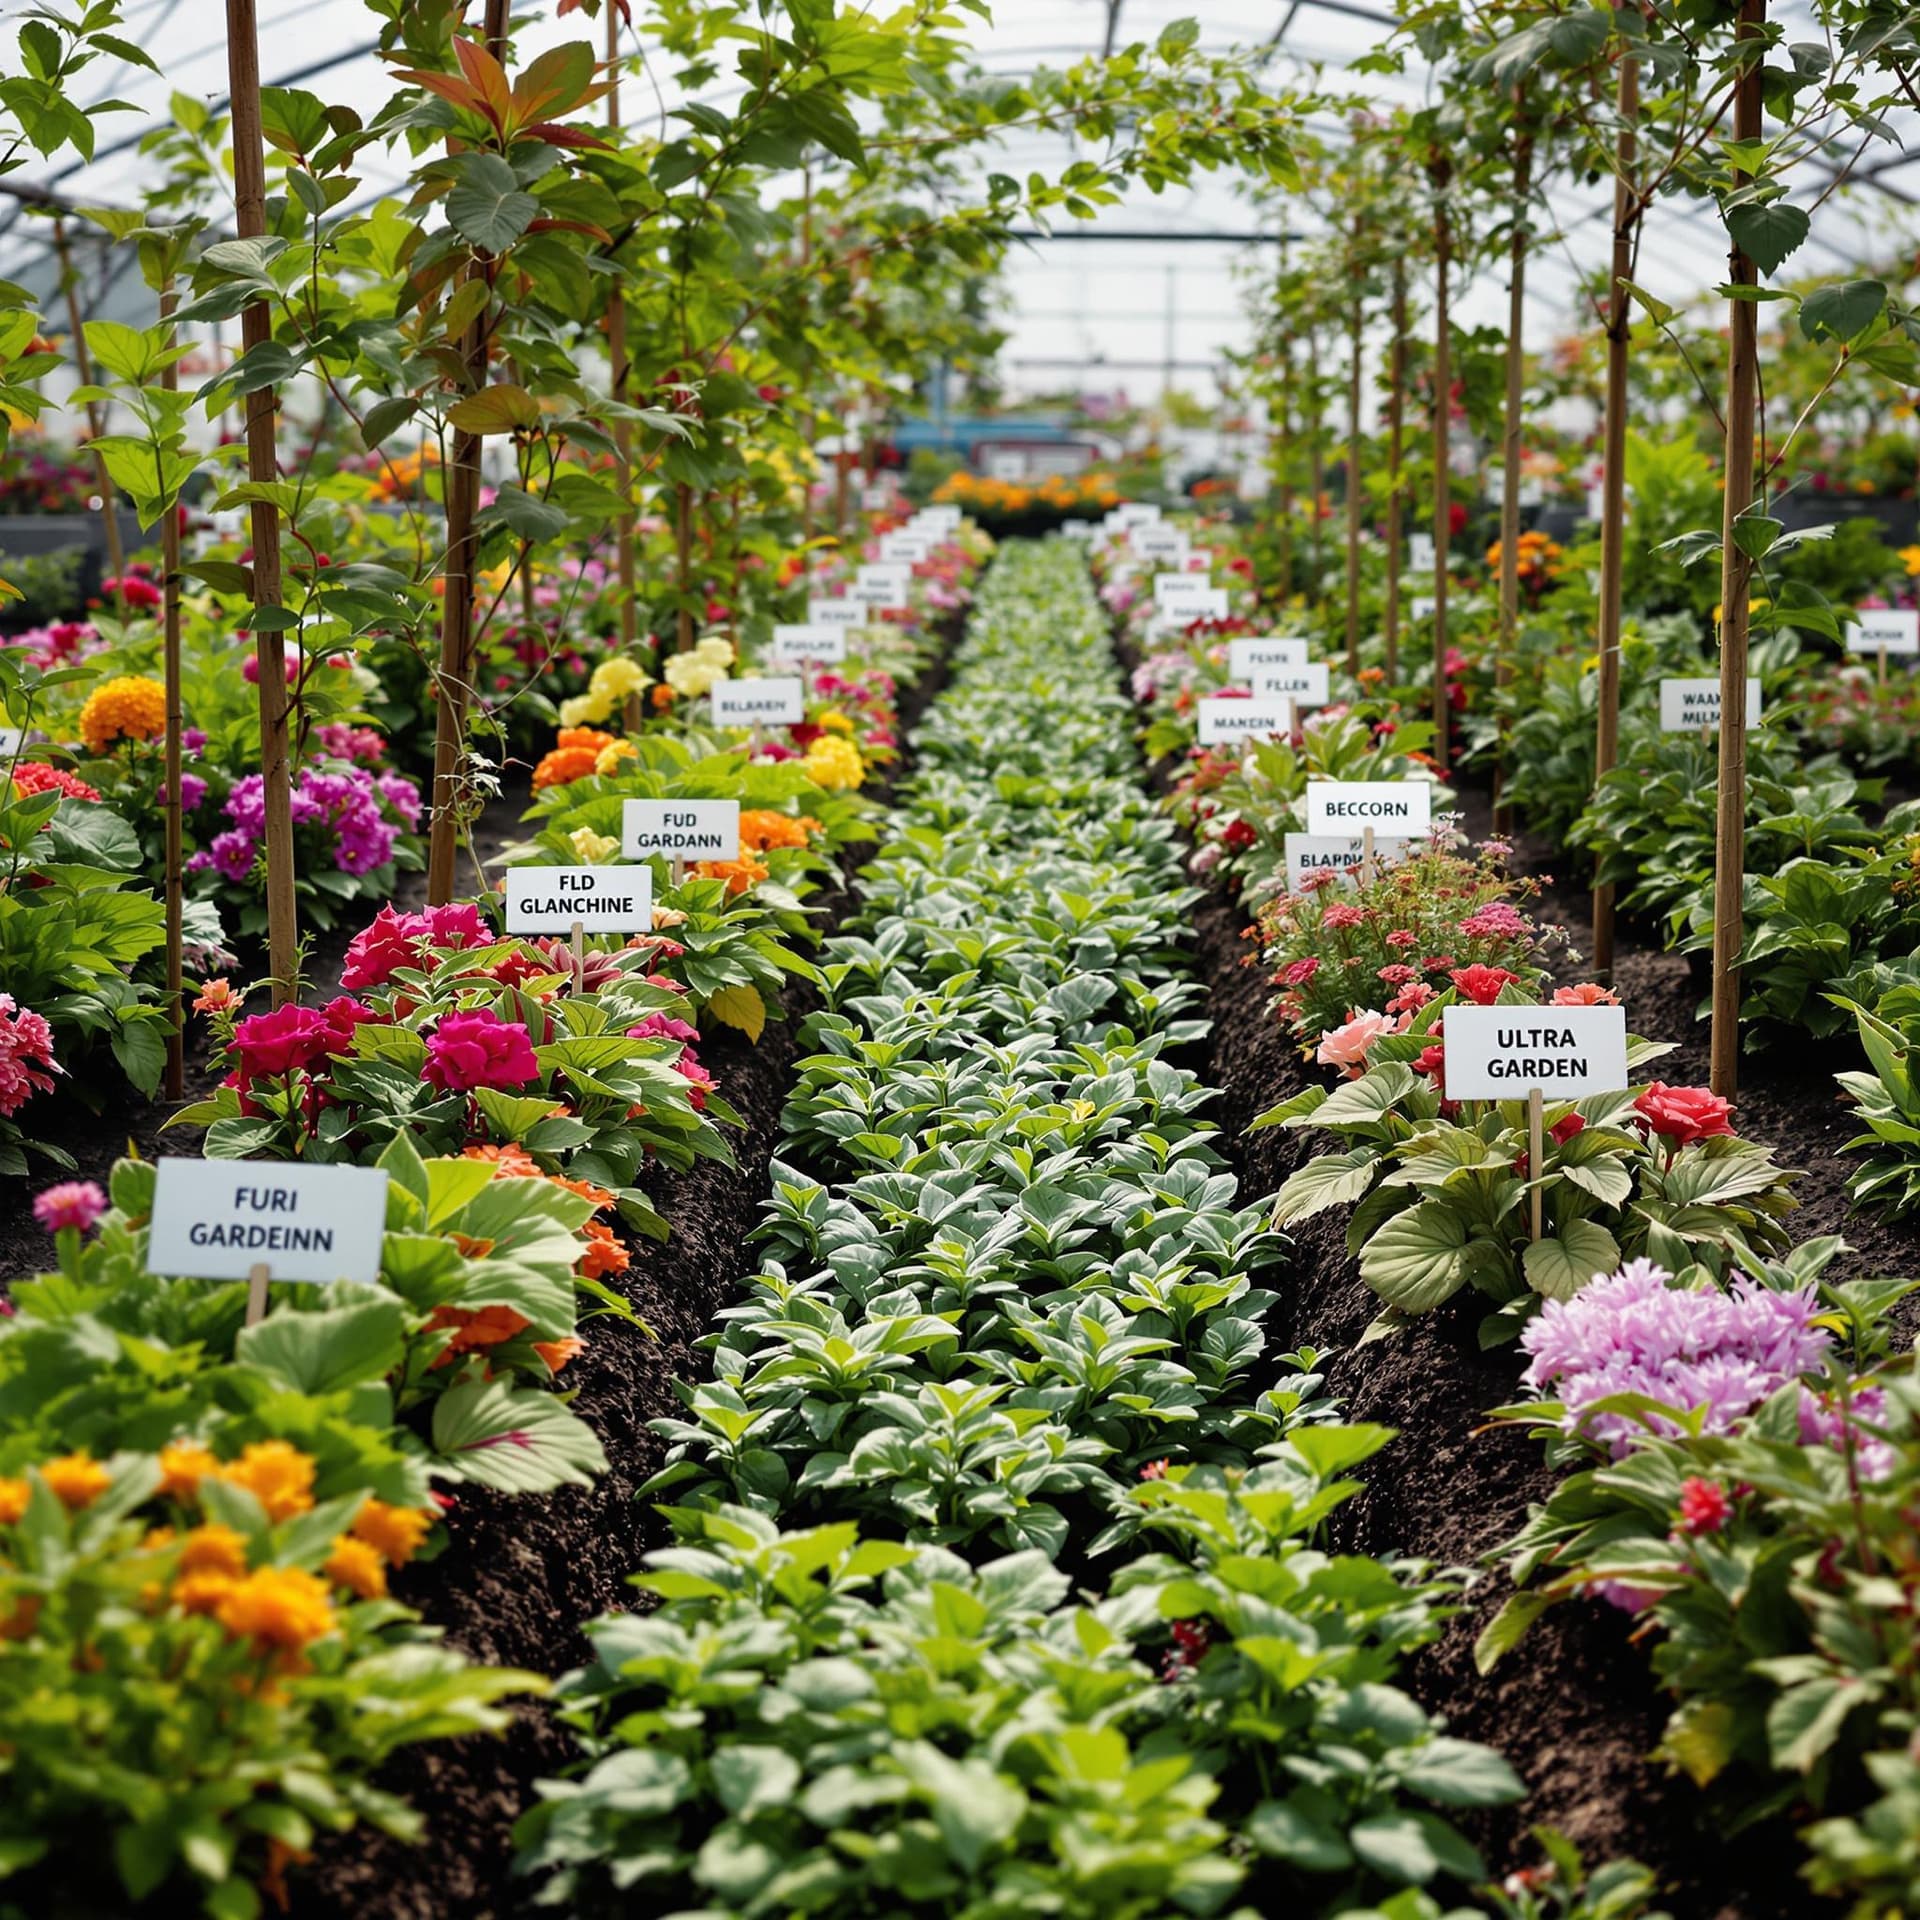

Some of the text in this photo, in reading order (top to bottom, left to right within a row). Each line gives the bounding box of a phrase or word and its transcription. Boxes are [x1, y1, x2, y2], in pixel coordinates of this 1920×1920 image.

[1326, 802, 1408, 817] BECCORN
[663, 813, 697, 828] FUD
[637, 833, 722, 848] GARDANN
[560, 875, 595, 891] FLD
[520, 897, 634, 914] GLANCHINE
[1497, 1029, 1577, 1048] ULTRA
[1487, 1058, 1588, 1078] GARDEN
[234, 1187, 298, 1212] FURI
[189, 1222, 333, 1252] GARDEINN
